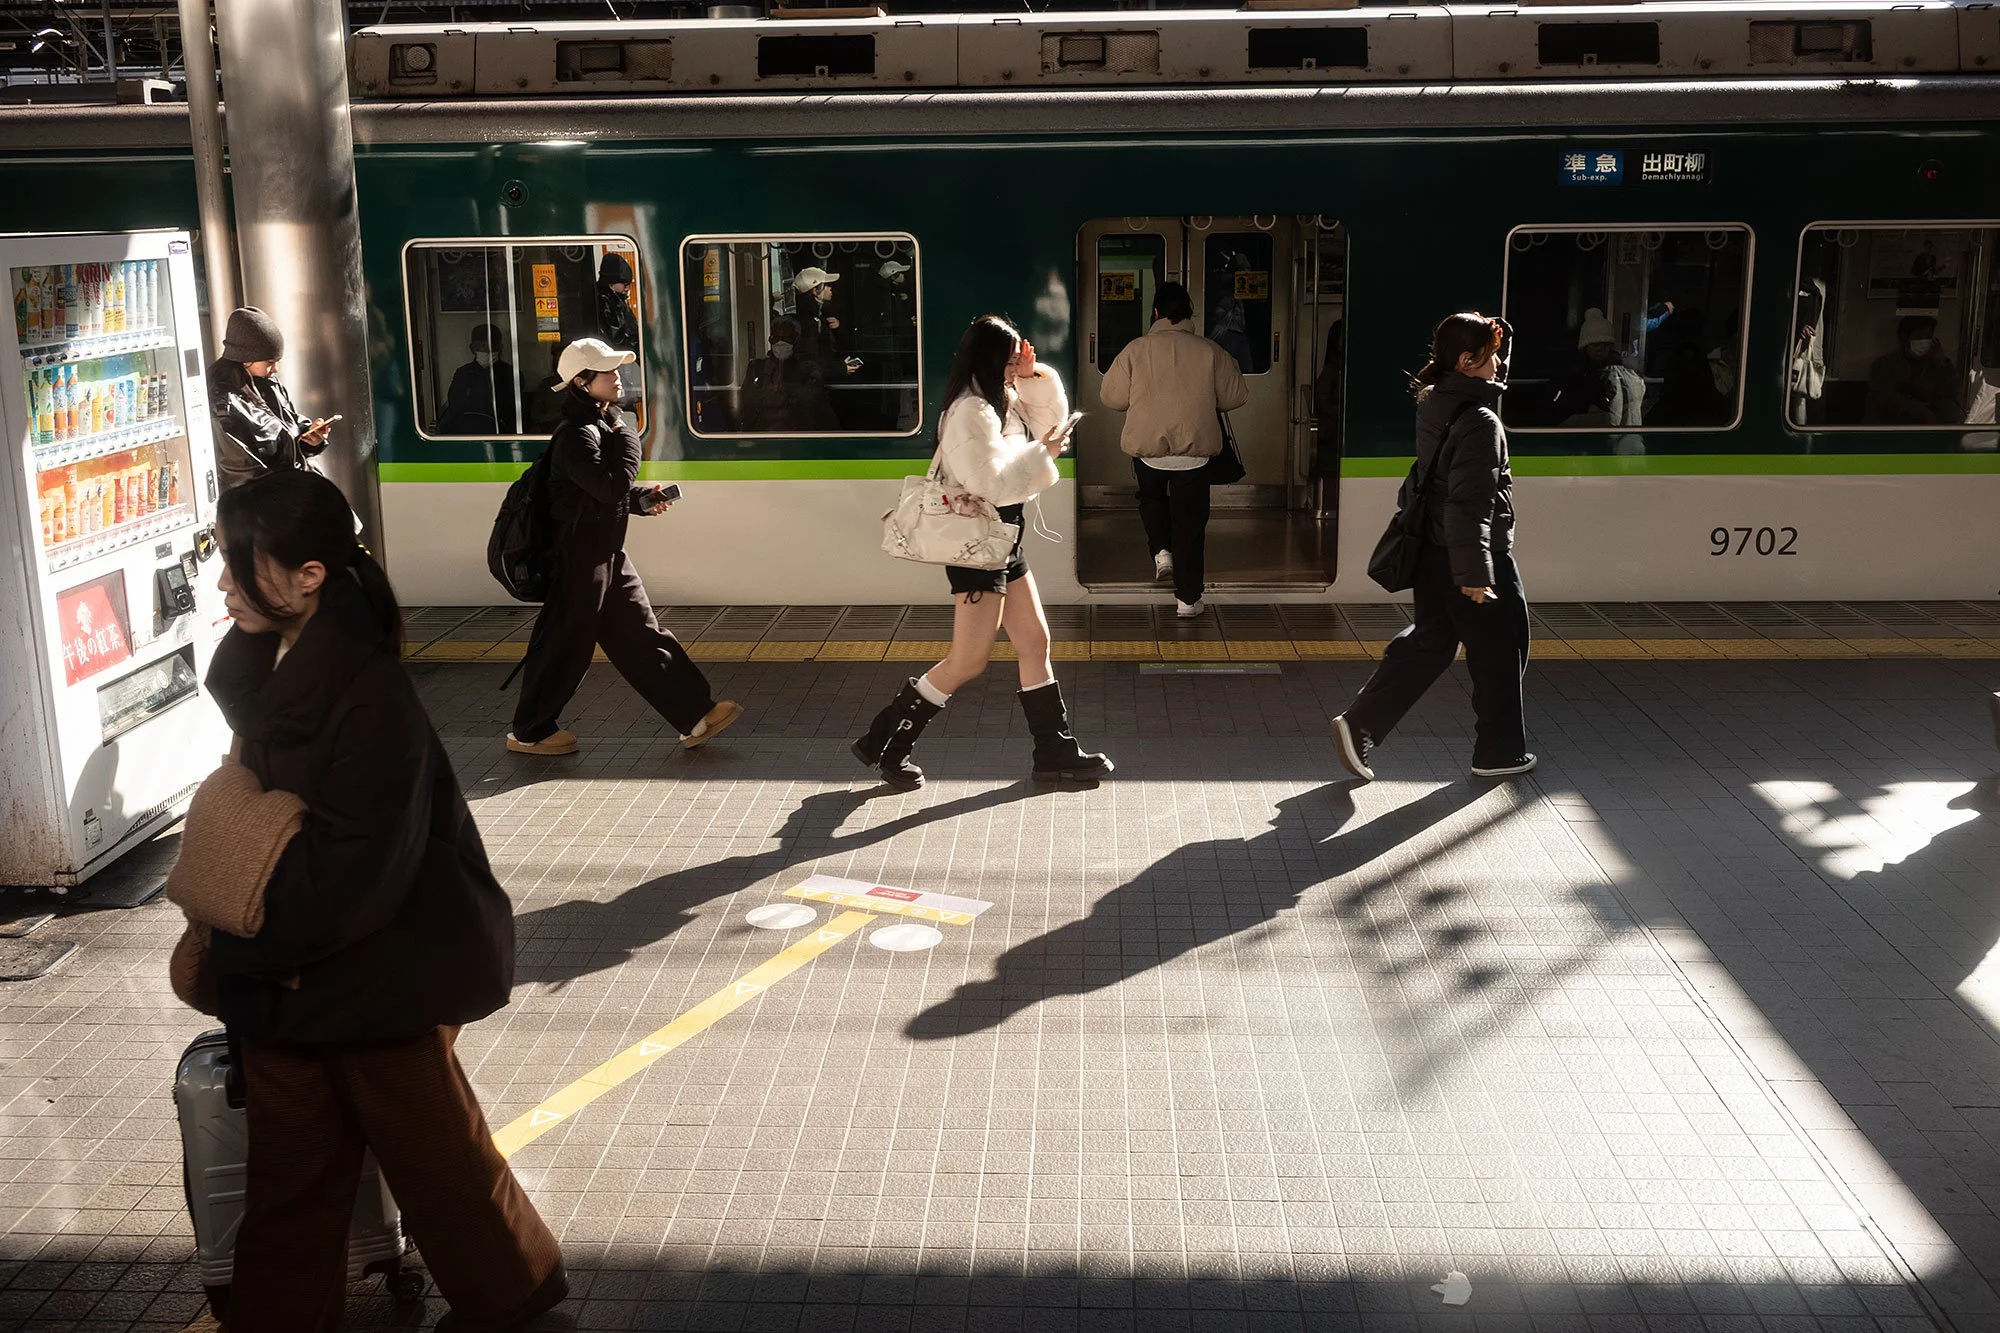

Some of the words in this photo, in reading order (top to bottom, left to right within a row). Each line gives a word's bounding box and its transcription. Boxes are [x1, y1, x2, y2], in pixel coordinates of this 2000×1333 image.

[1642, 153, 1705, 173] 出町柳
[1642, 173, 1704, 181] Demachiyanagi
[76, 262, 111, 284] KIRIN
[1710, 527, 1798, 556] 9702
[62, 623, 123, 671] 午後の紅茶
